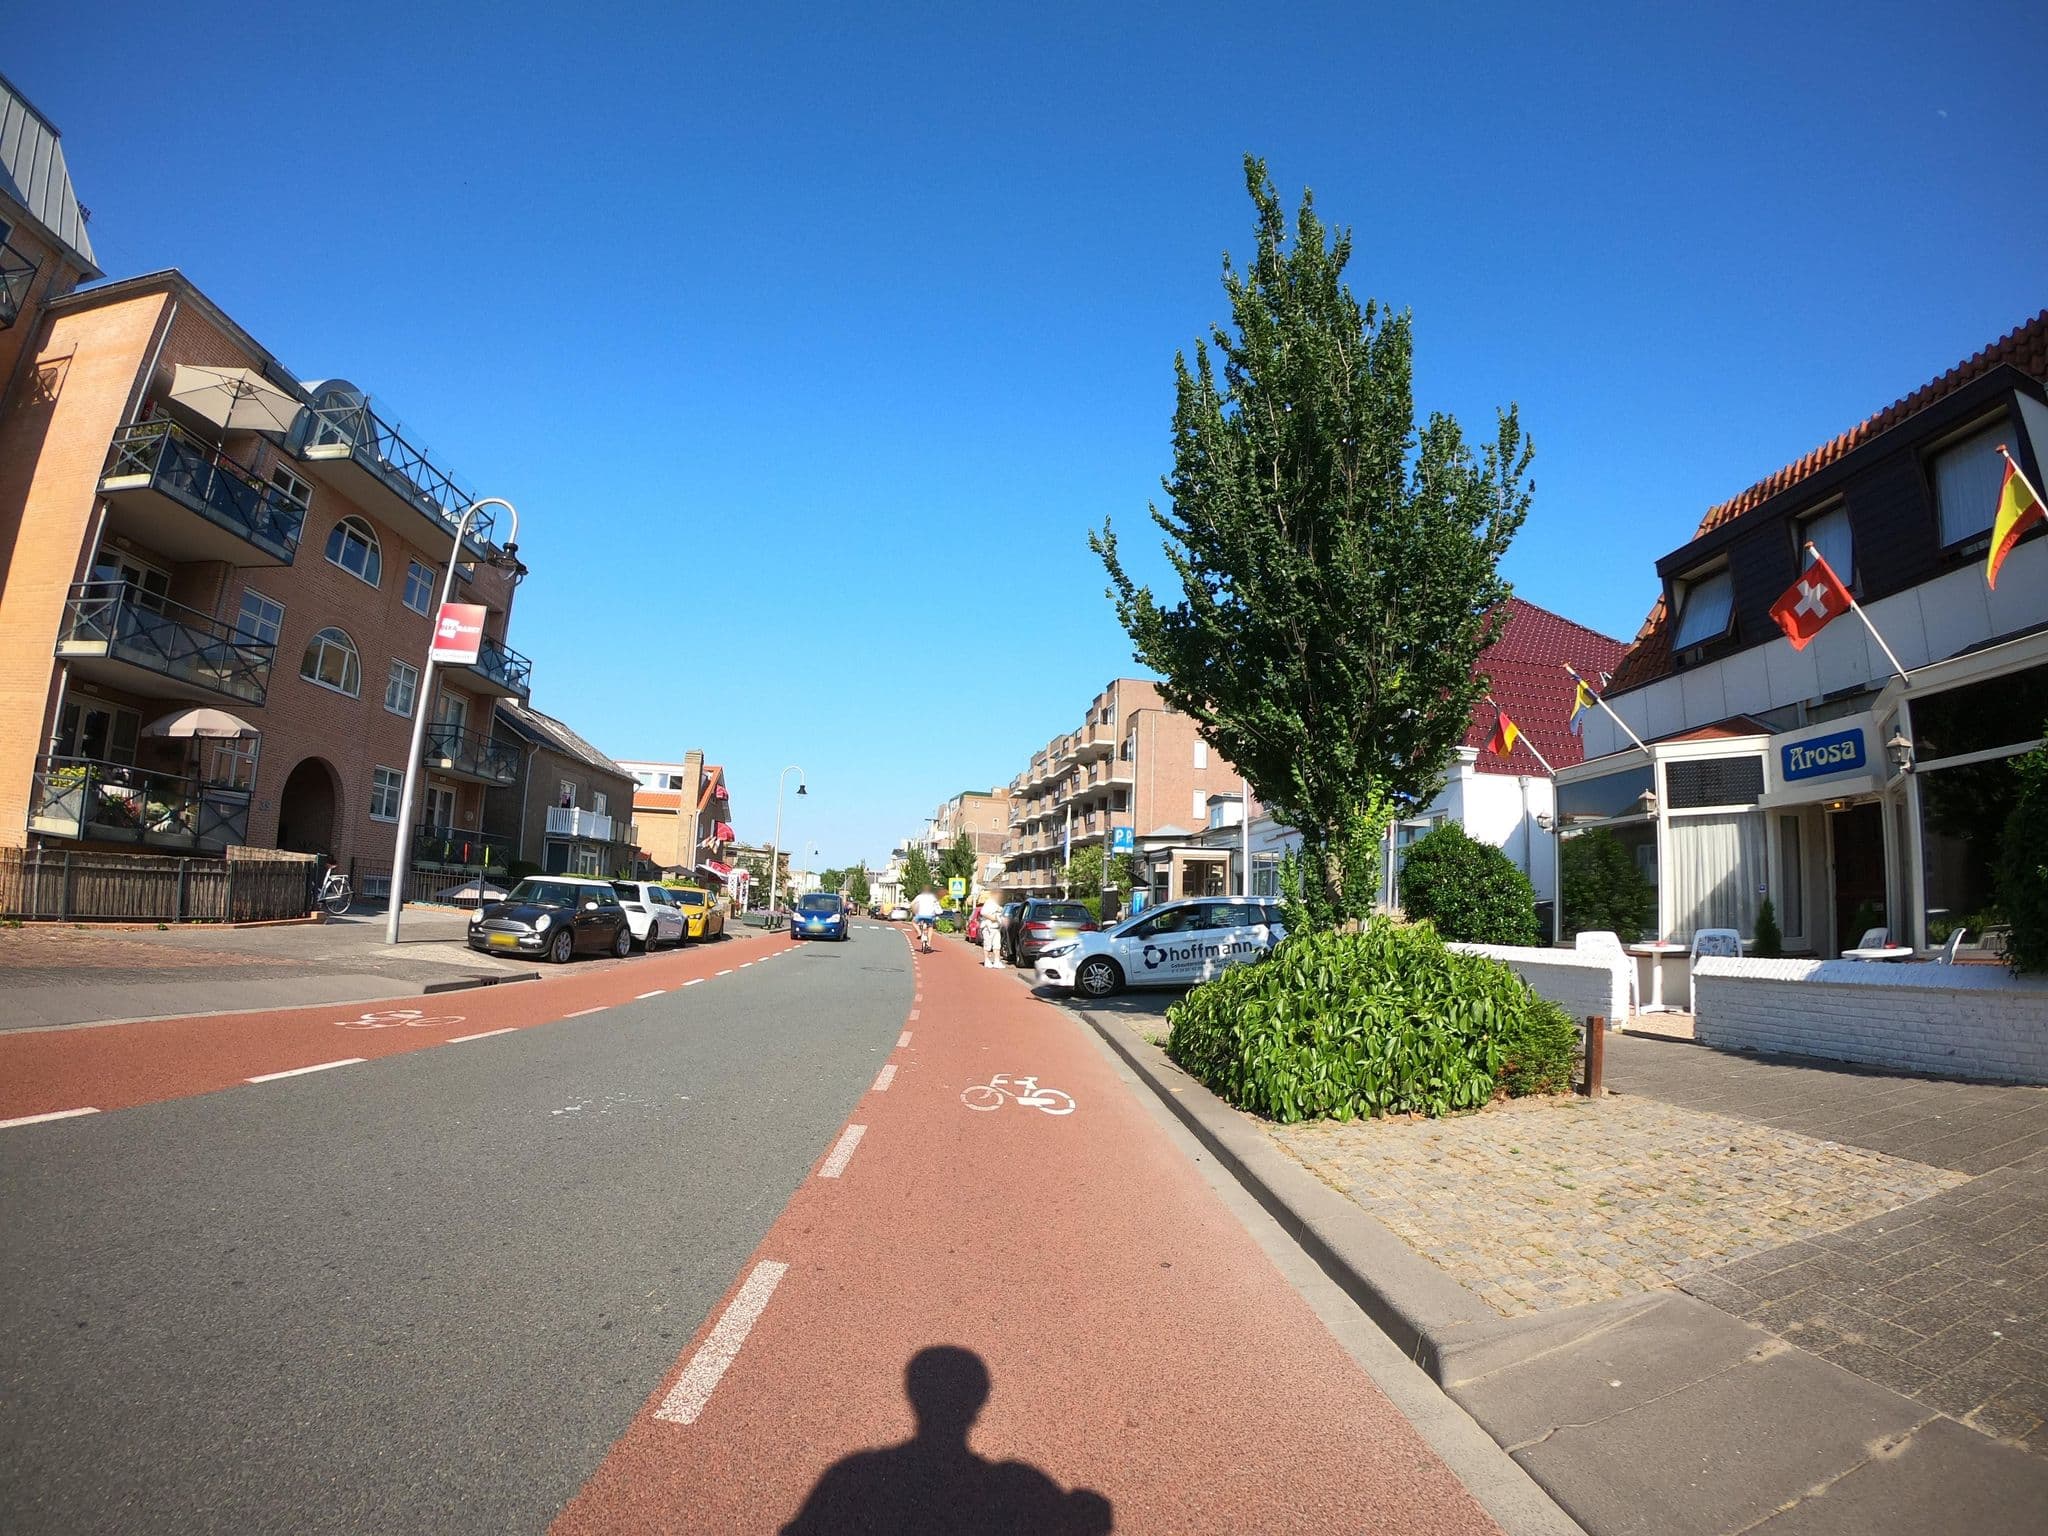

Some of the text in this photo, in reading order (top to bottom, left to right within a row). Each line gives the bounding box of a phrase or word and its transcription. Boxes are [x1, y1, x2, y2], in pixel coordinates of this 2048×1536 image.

[1789, 740, 1857, 772] Arosa
[1115, 829, 1124, 843] P
[1169, 941, 1253, 961] hoffmann
